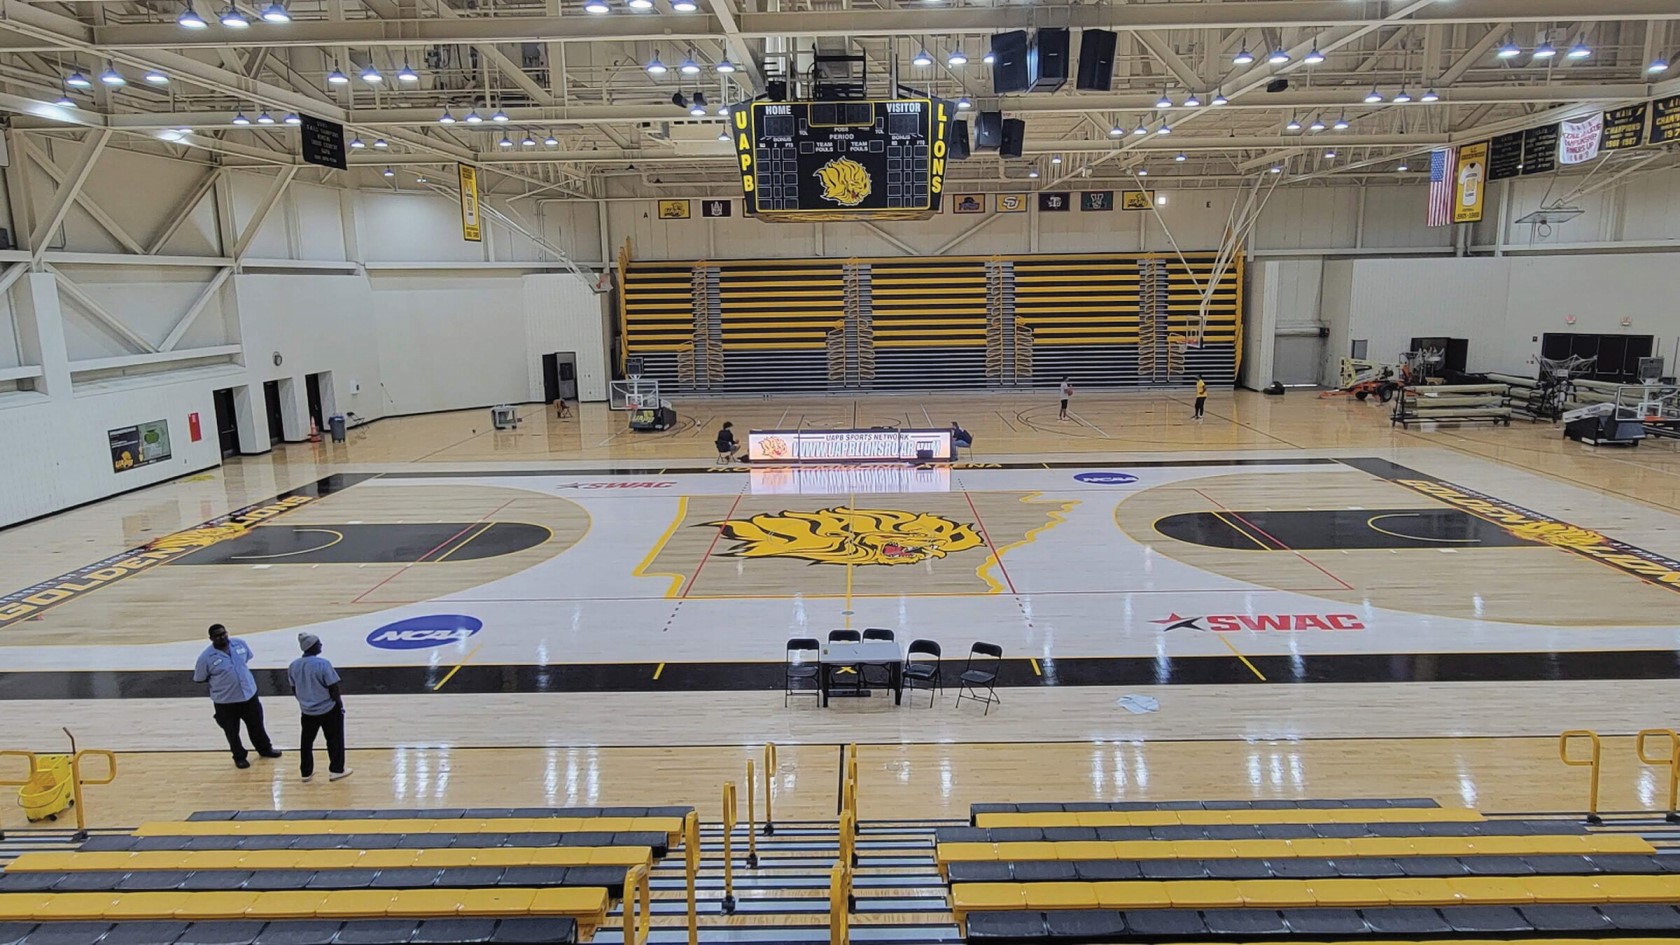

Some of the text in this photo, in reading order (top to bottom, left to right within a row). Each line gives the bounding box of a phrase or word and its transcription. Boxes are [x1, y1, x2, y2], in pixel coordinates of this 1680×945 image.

[765, 105, 792, 115] HOME
[886, 103, 921, 113] VISITOR
[735, 111, 754, 192] UAPB
[931, 103, 947, 194] LIONS
[845, 433, 873, 441] SPORTS
[583, 481, 678, 489] SWAC
[1396, 479, 1535, 524] GOLDEN
[0, 547, 186, 621] GOLDEN
[1206, 614, 1365, 631] SWAC
[372, 629, 474, 642] NCAA
